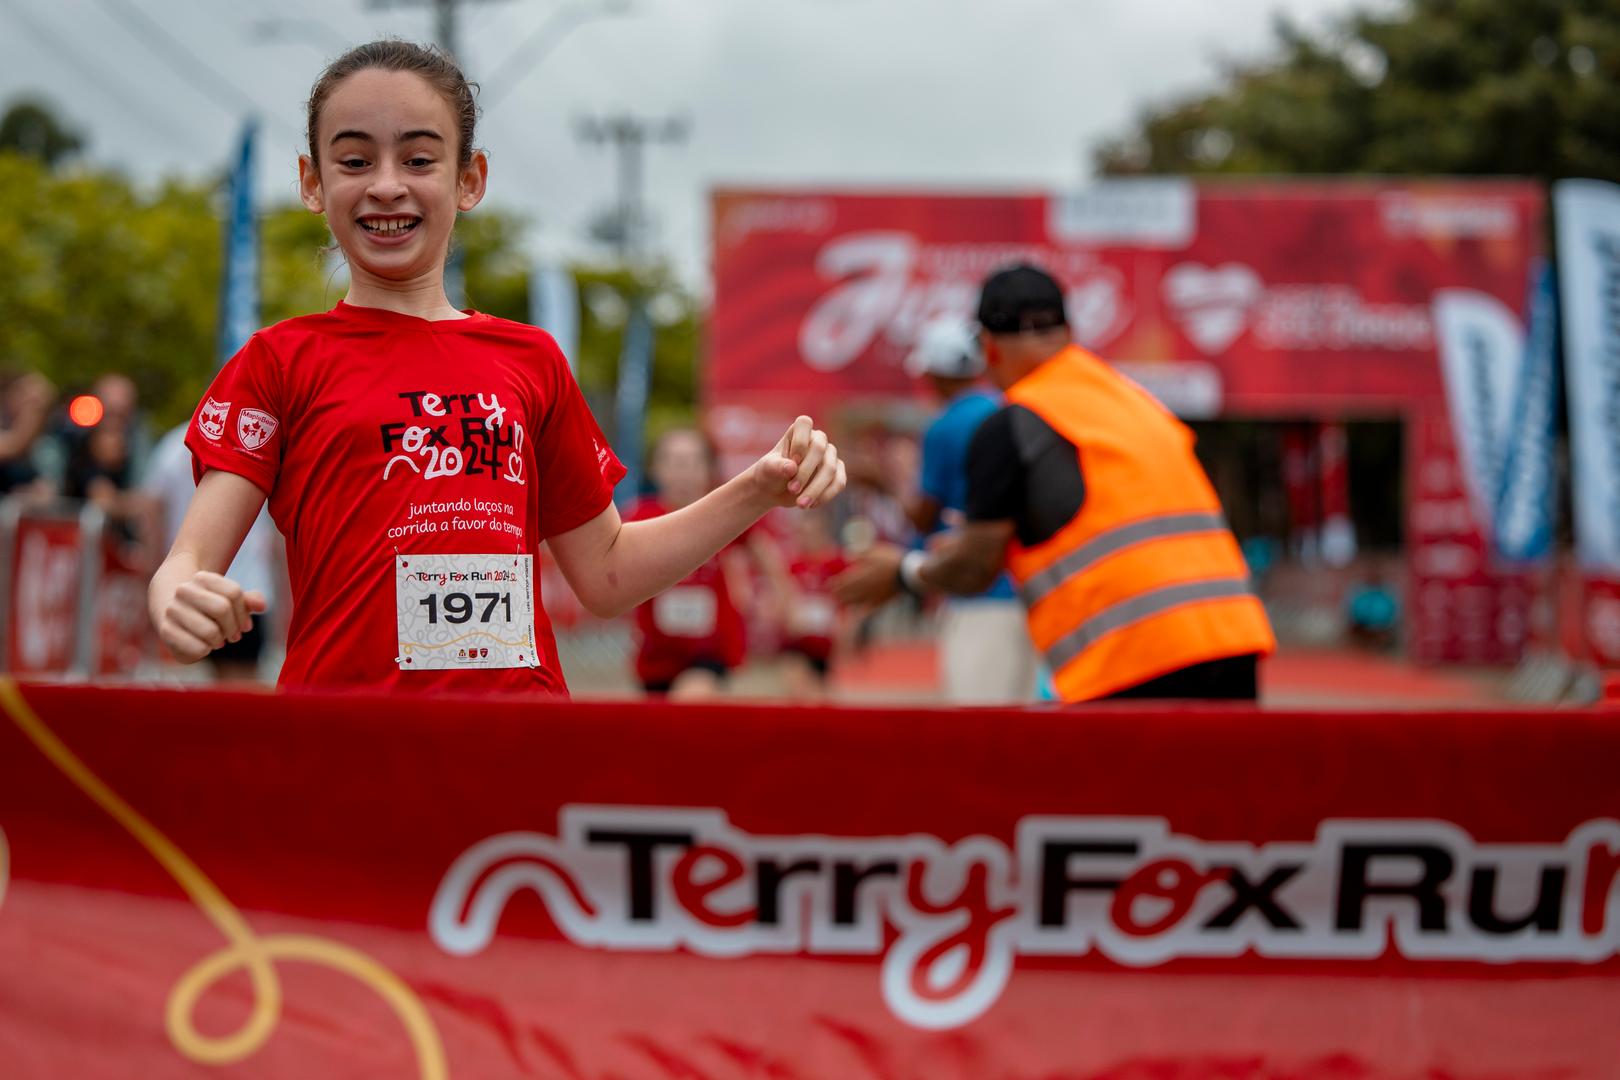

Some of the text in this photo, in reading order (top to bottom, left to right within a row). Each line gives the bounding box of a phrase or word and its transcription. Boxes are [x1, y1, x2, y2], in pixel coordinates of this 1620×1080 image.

[398, 391, 506, 430] Terry
[381, 418, 524, 454] Fox Run
[420, 440, 503, 480] 2024
[408, 498, 514, 519] juntando laços na
[388, 516, 523, 539] corrida a favor do tempo
[416, 570, 510, 586] Terry Fox Run 2024
[419, 592, 512, 625] 1971
[587, 827, 1016, 1003] Terry
[1037, 840, 1306, 938] Fox
